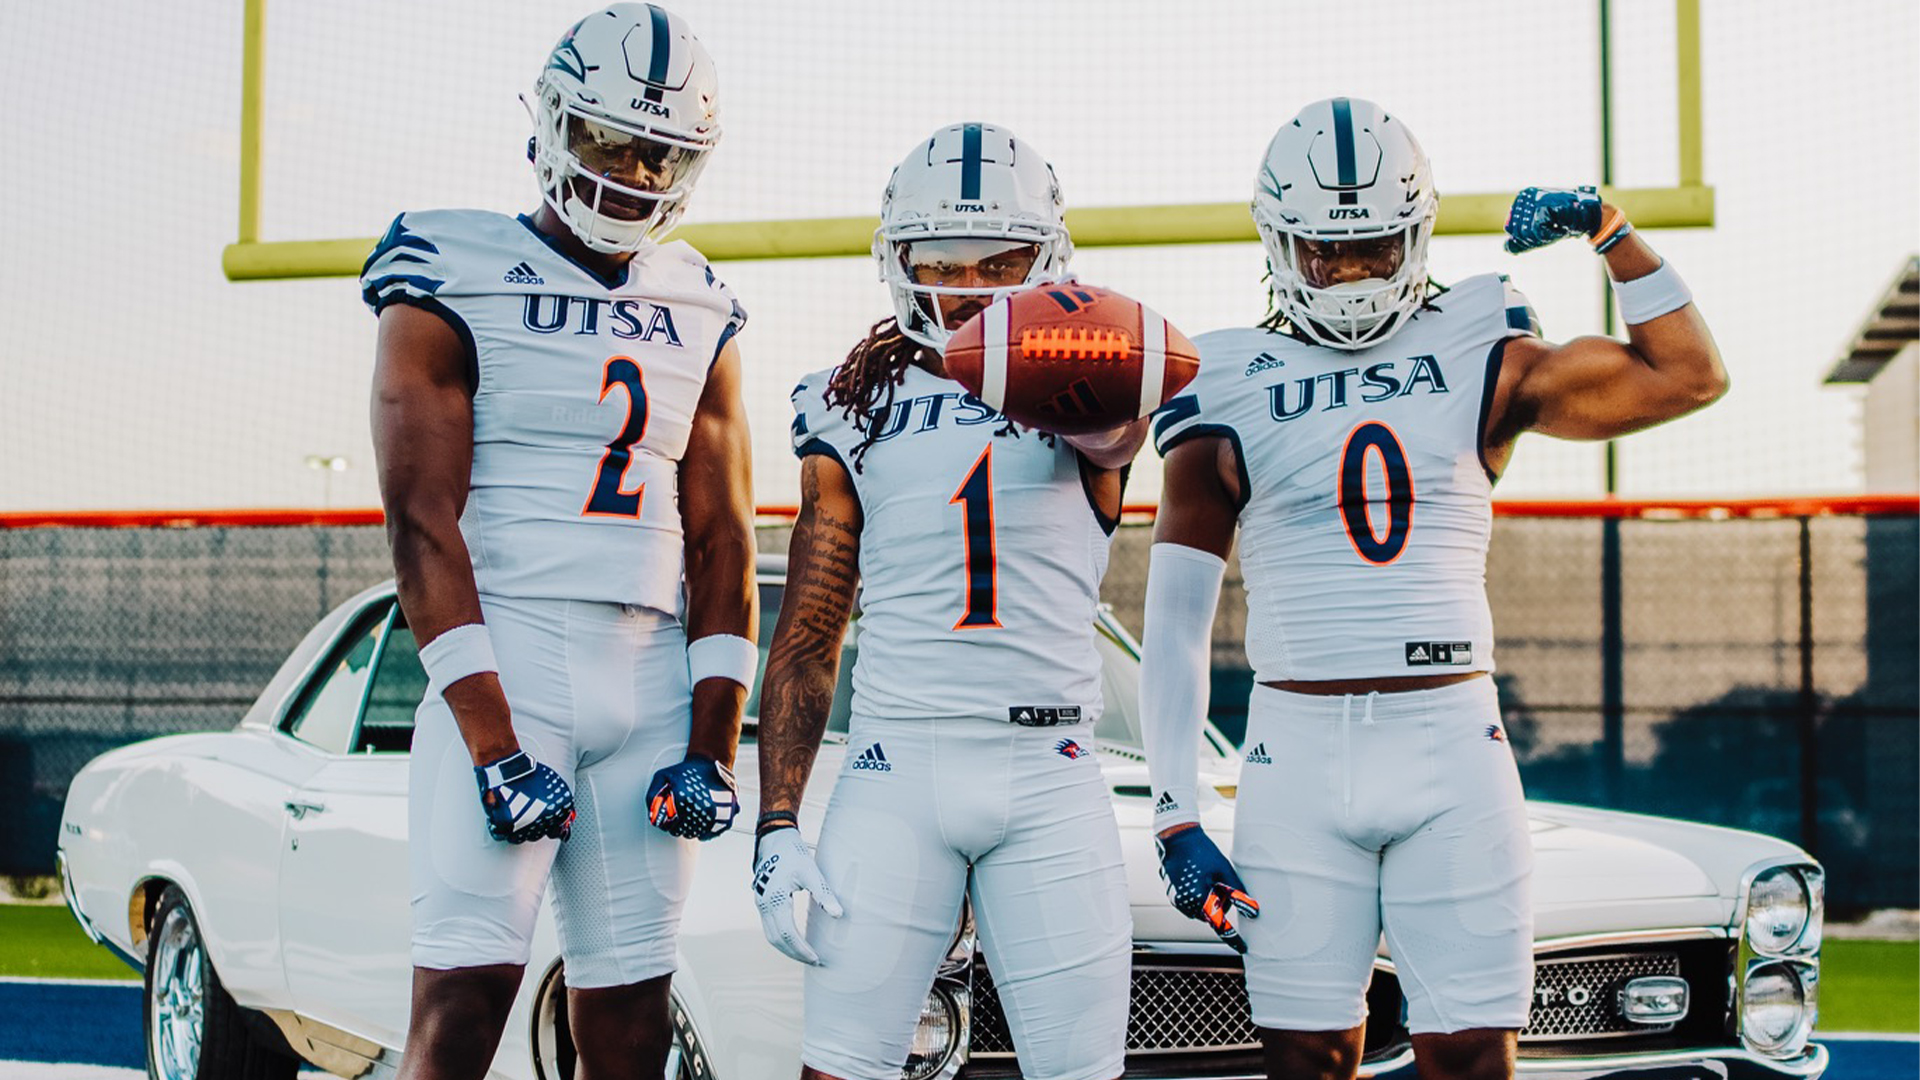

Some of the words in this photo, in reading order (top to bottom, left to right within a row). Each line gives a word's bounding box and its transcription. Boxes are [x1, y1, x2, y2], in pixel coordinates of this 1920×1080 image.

[630, 97, 670, 119] UTSA
[955, 203, 985, 213] UTSA
[1328, 207, 1370, 220] UTSA
[503, 274, 545, 285] adidas
[522, 294, 684, 348] UTSA
[1244, 360, 1286, 377] adidas
[1263, 354, 1450, 423] UTSA
[864, 392, 1007, 443] UTS
[579, 354, 651, 520] 2
[1337, 419, 1416, 567] 0
[948, 440, 1005, 631] 1
[851, 758, 892, 772] adidas
[1535, 984, 1590, 1006] TO
